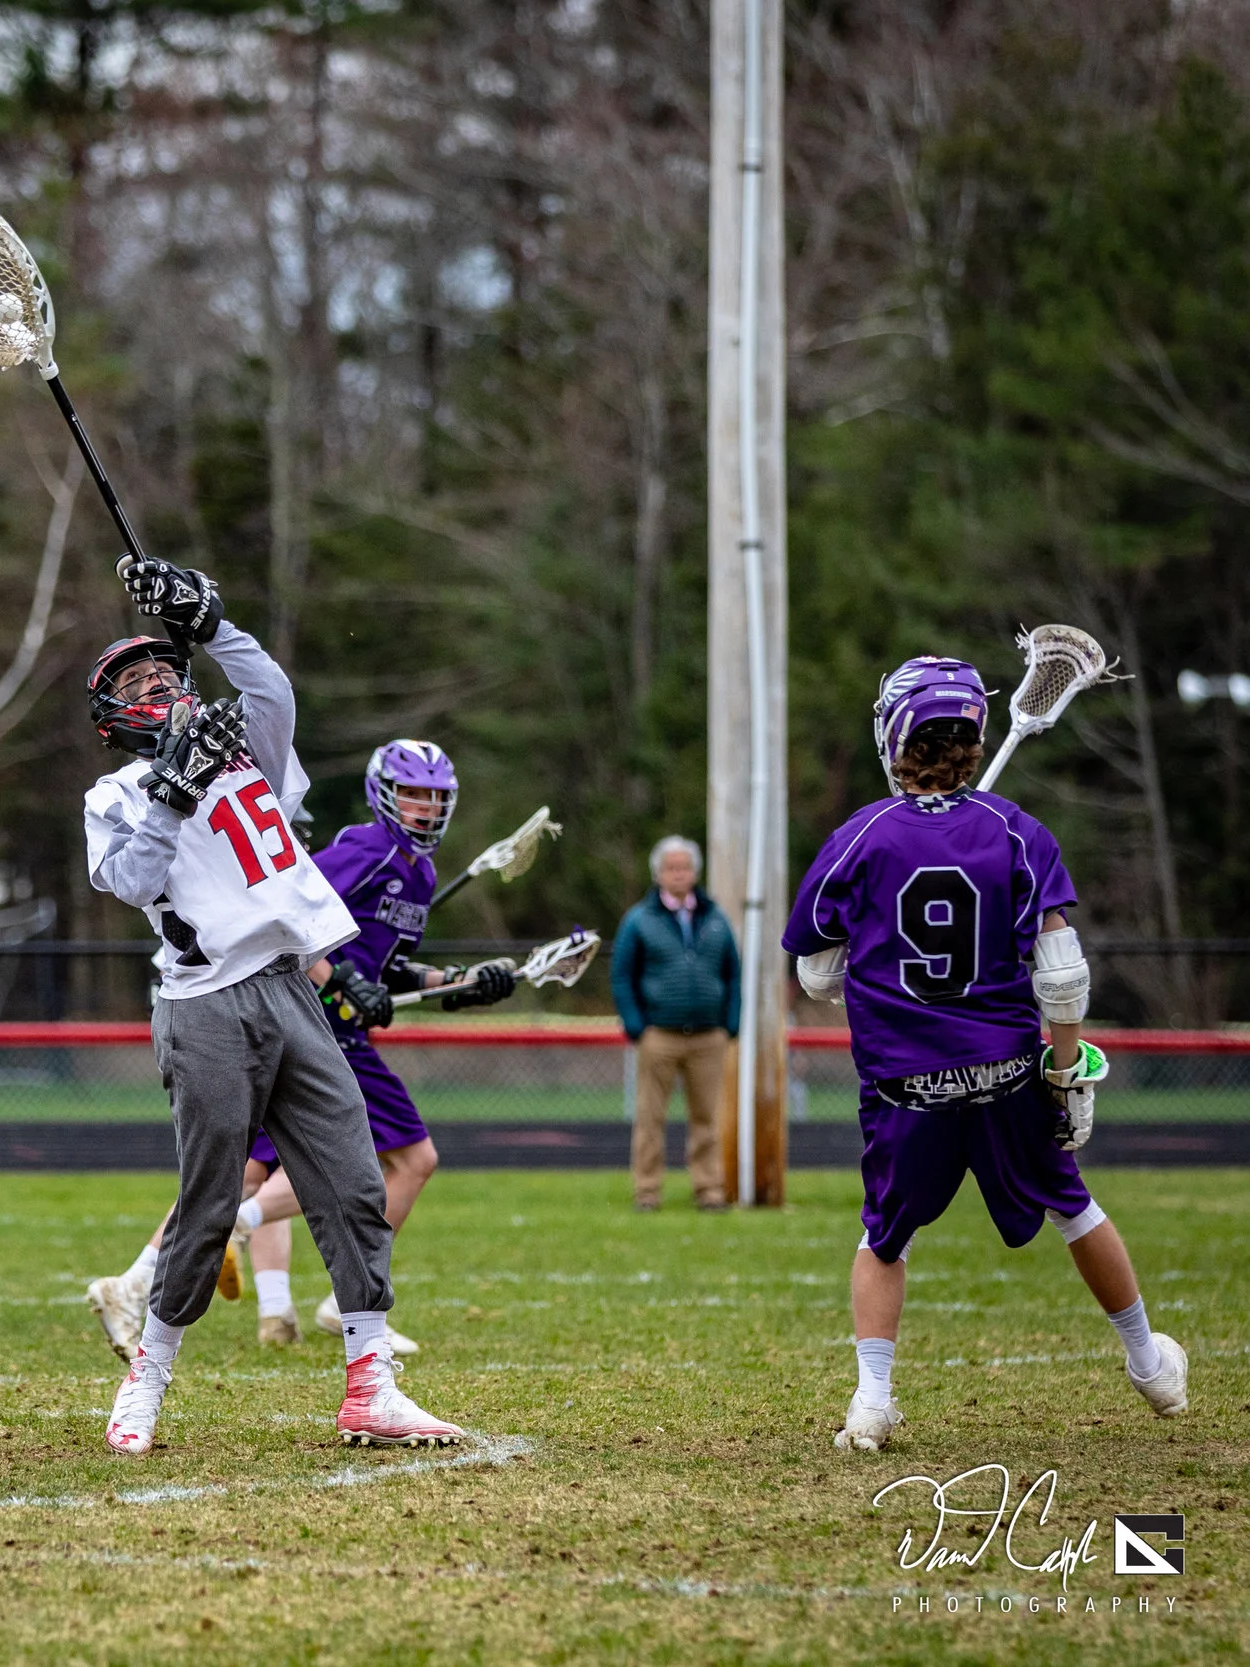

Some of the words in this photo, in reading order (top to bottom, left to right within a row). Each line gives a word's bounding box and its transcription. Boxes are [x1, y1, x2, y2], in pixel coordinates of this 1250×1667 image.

[190, 576, 211, 630] BRINE
[946, 672, 955, 681] 9
[161, 767, 206, 800] BRINE
[208, 778, 297, 889] 15
[897, 866, 981, 1003] 9
